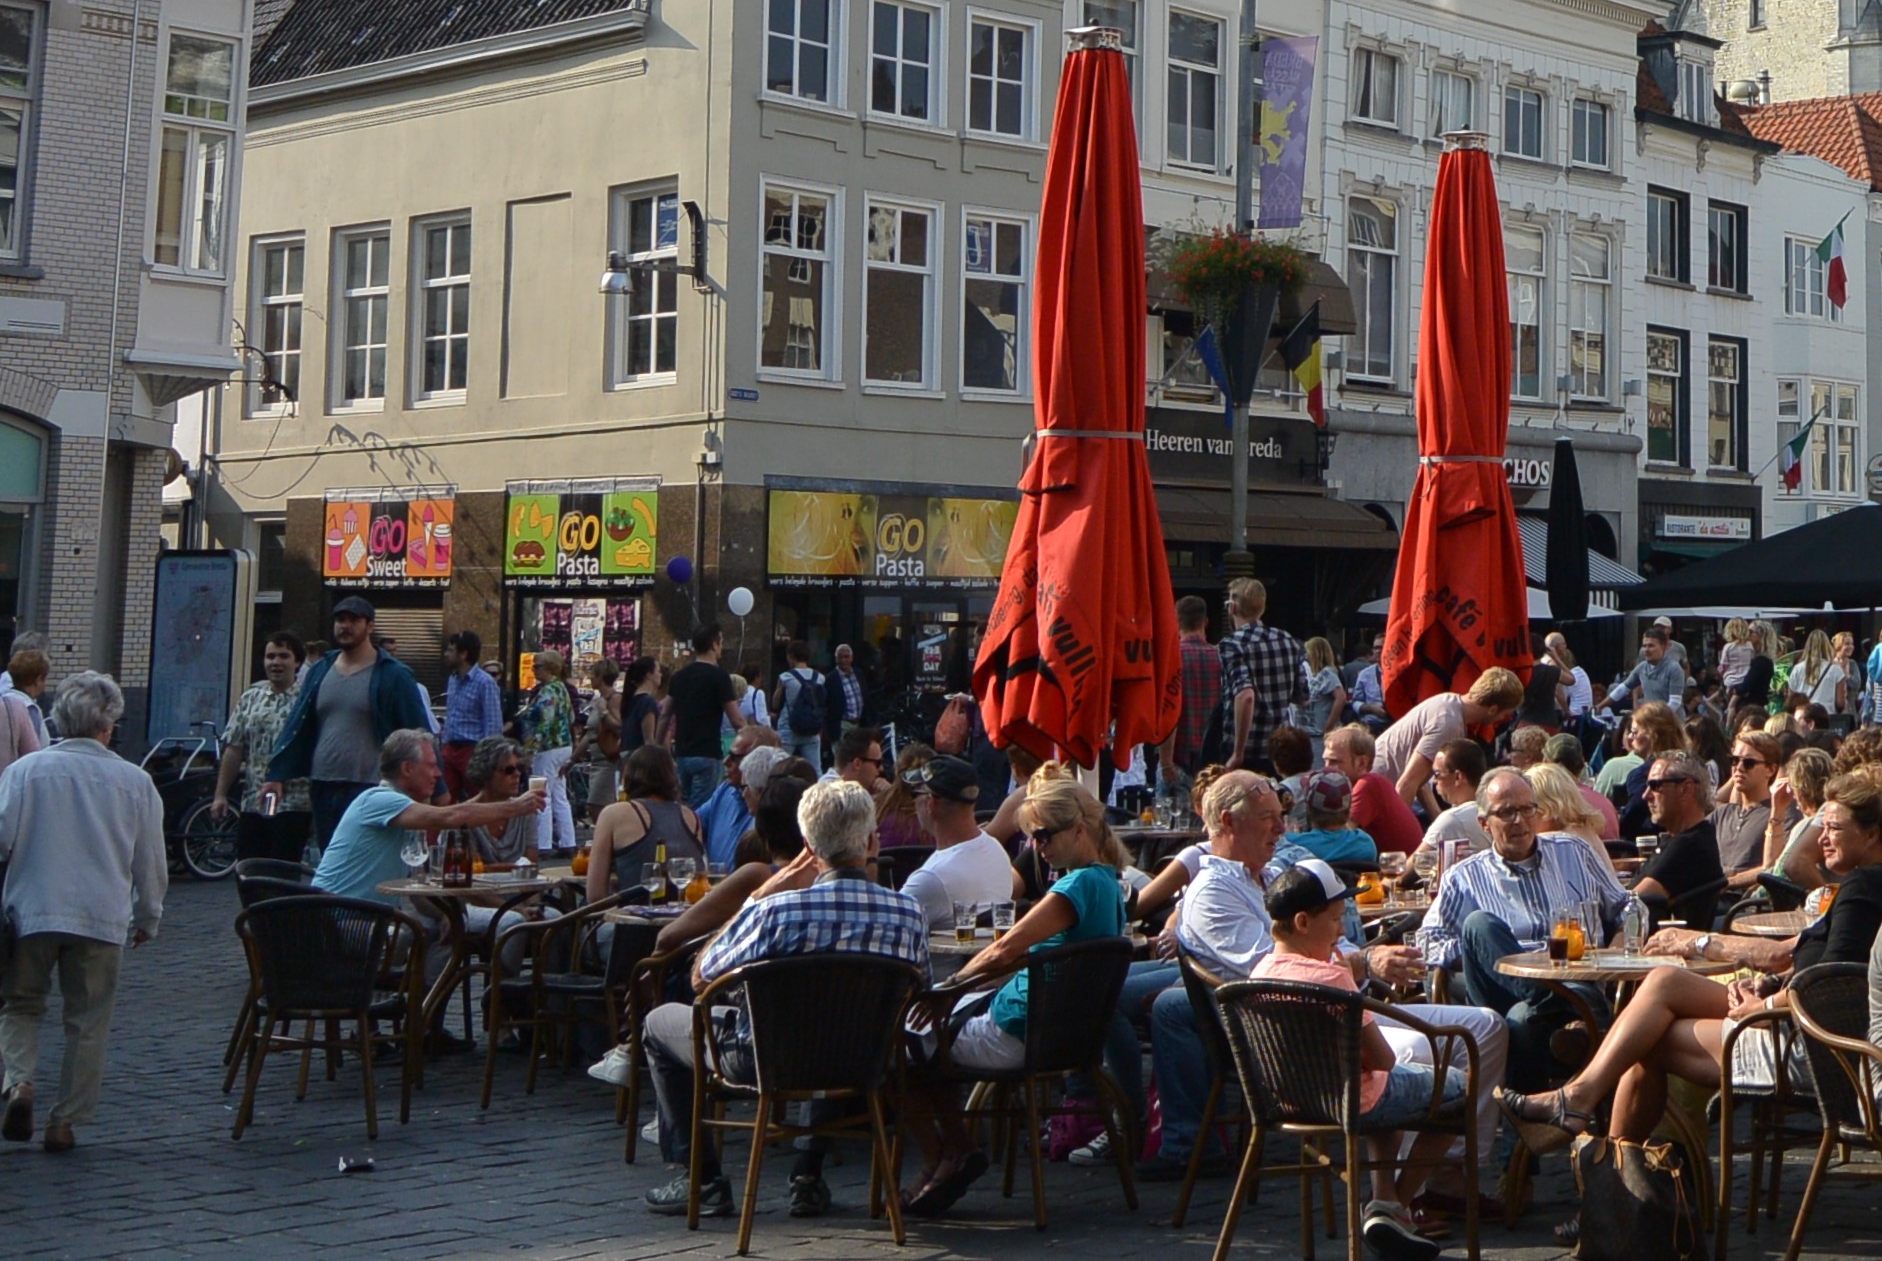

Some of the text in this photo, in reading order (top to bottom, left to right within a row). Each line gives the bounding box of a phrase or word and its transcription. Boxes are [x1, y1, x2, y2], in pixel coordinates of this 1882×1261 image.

[1145, 428, 1283, 459] Heeren van reda
[1502, 457, 1550, 487] CHOS
[370, 517, 405, 555] GO
[559, 513, 600, 552] GO
[880, 517, 925, 553] GO
[366, 555, 407, 577] Sweet
[556, 552, 599, 576] Pasta
[875, 553, 924, 577] Pasta
[1435, 585, 1484, 631] café
[923, 661, 940, 671] DAY
